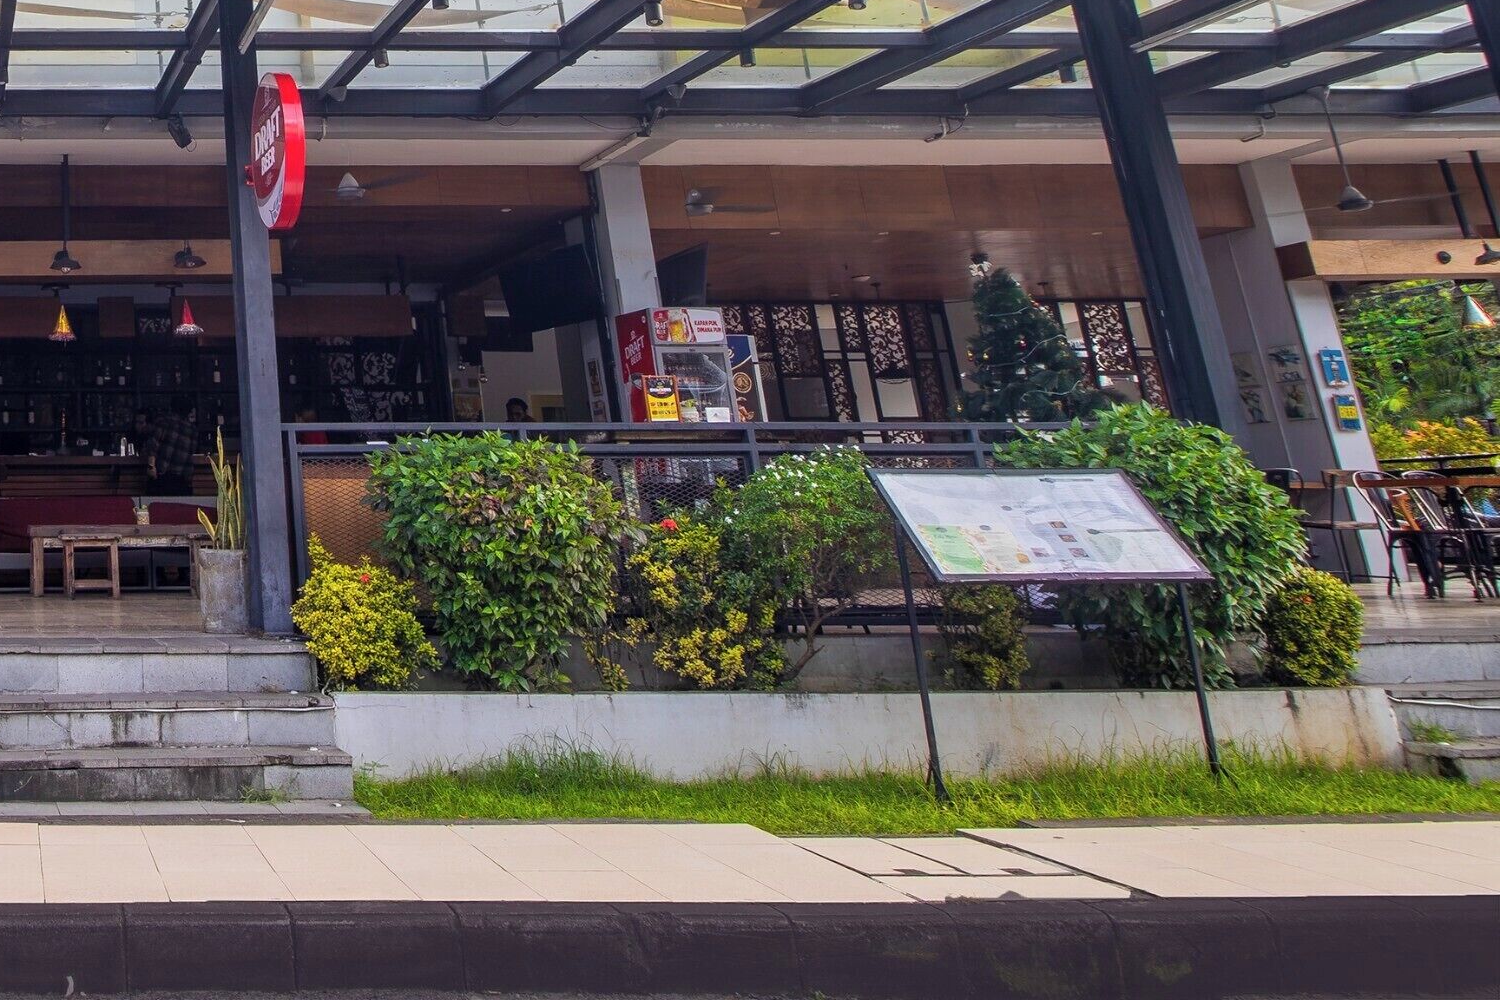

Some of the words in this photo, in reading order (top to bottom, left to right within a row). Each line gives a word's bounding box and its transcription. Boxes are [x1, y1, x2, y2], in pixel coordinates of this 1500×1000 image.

[254, 105, 281, 162] DRAFT
[261, 146, 275, 176] BEER
[624, 335, 645, 360] DRAFT
